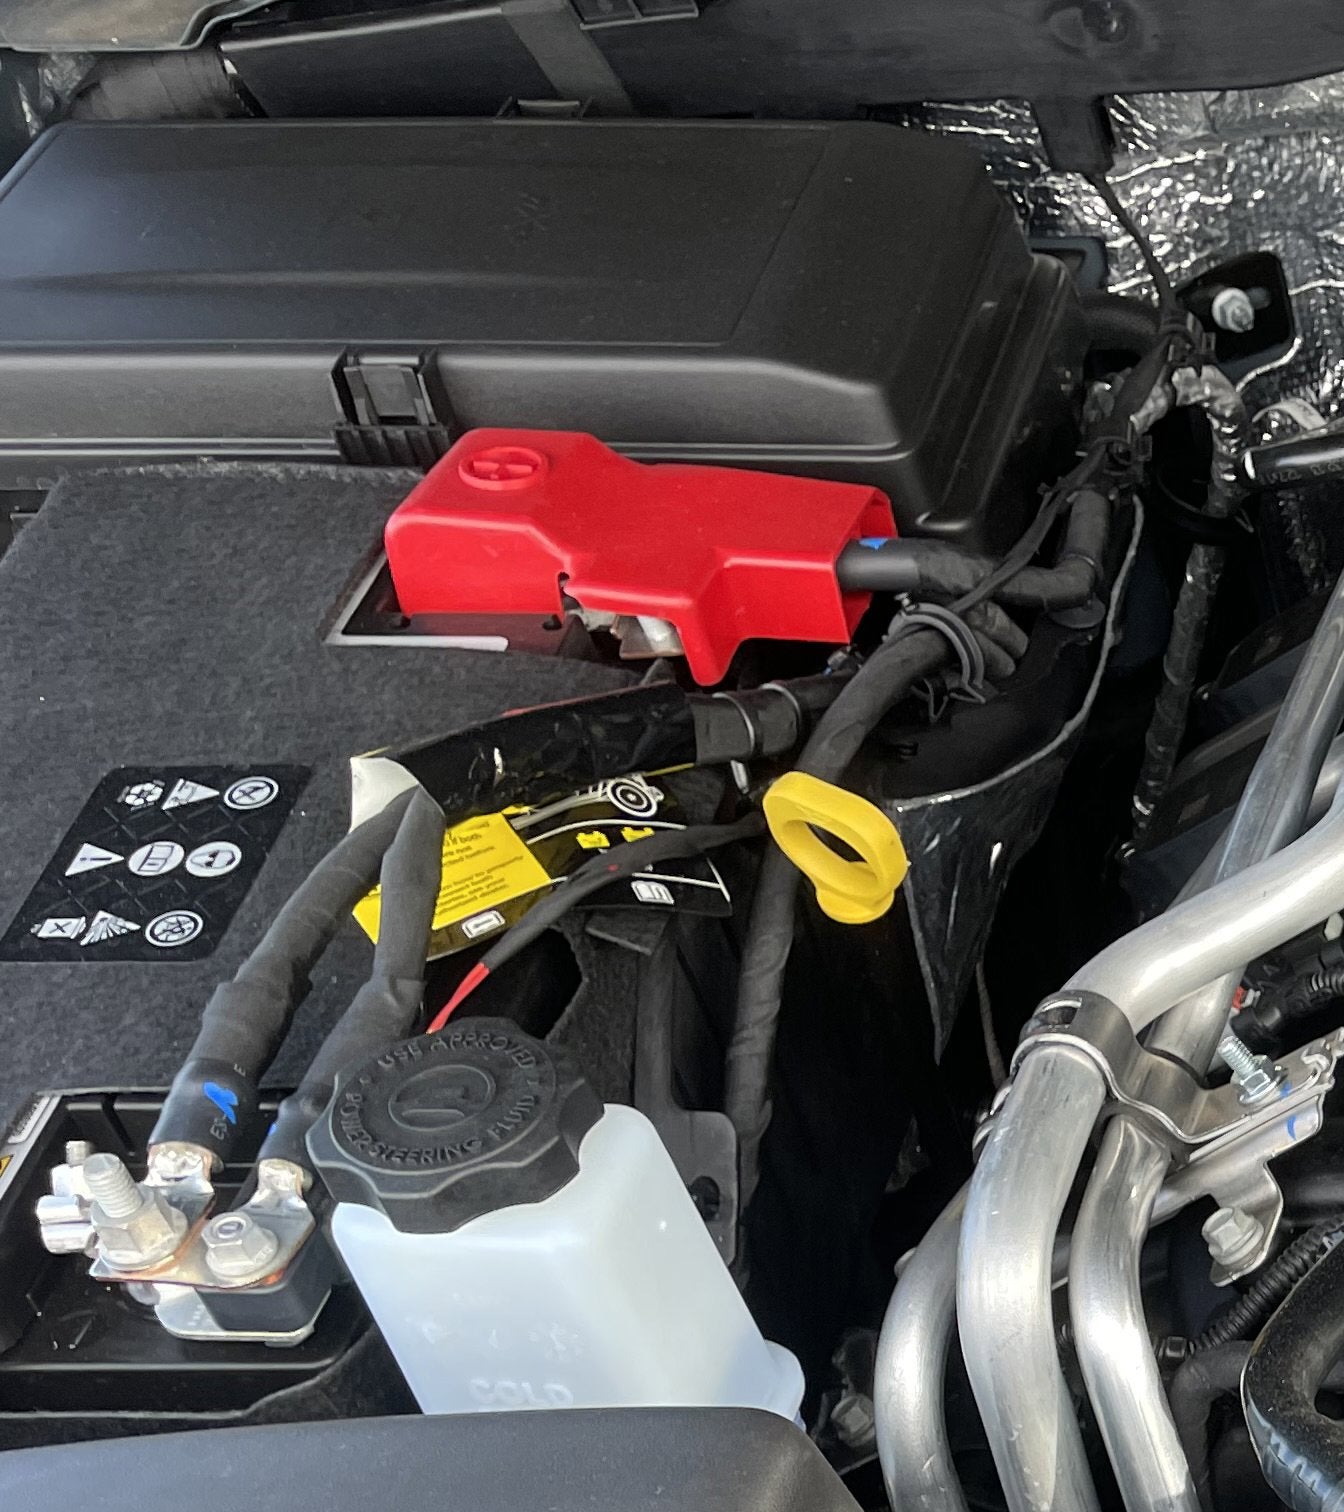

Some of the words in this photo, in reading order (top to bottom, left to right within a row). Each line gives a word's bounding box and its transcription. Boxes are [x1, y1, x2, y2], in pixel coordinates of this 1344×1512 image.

[377, 1043, 423, 1069] USE
[430, 1032, 537, 1070] APPROVED
[340, 1092, 373, 1149] POWER
[368, 1137, 483, 1164] STEERING
[487, 1094, 539, 1140] FLUID
